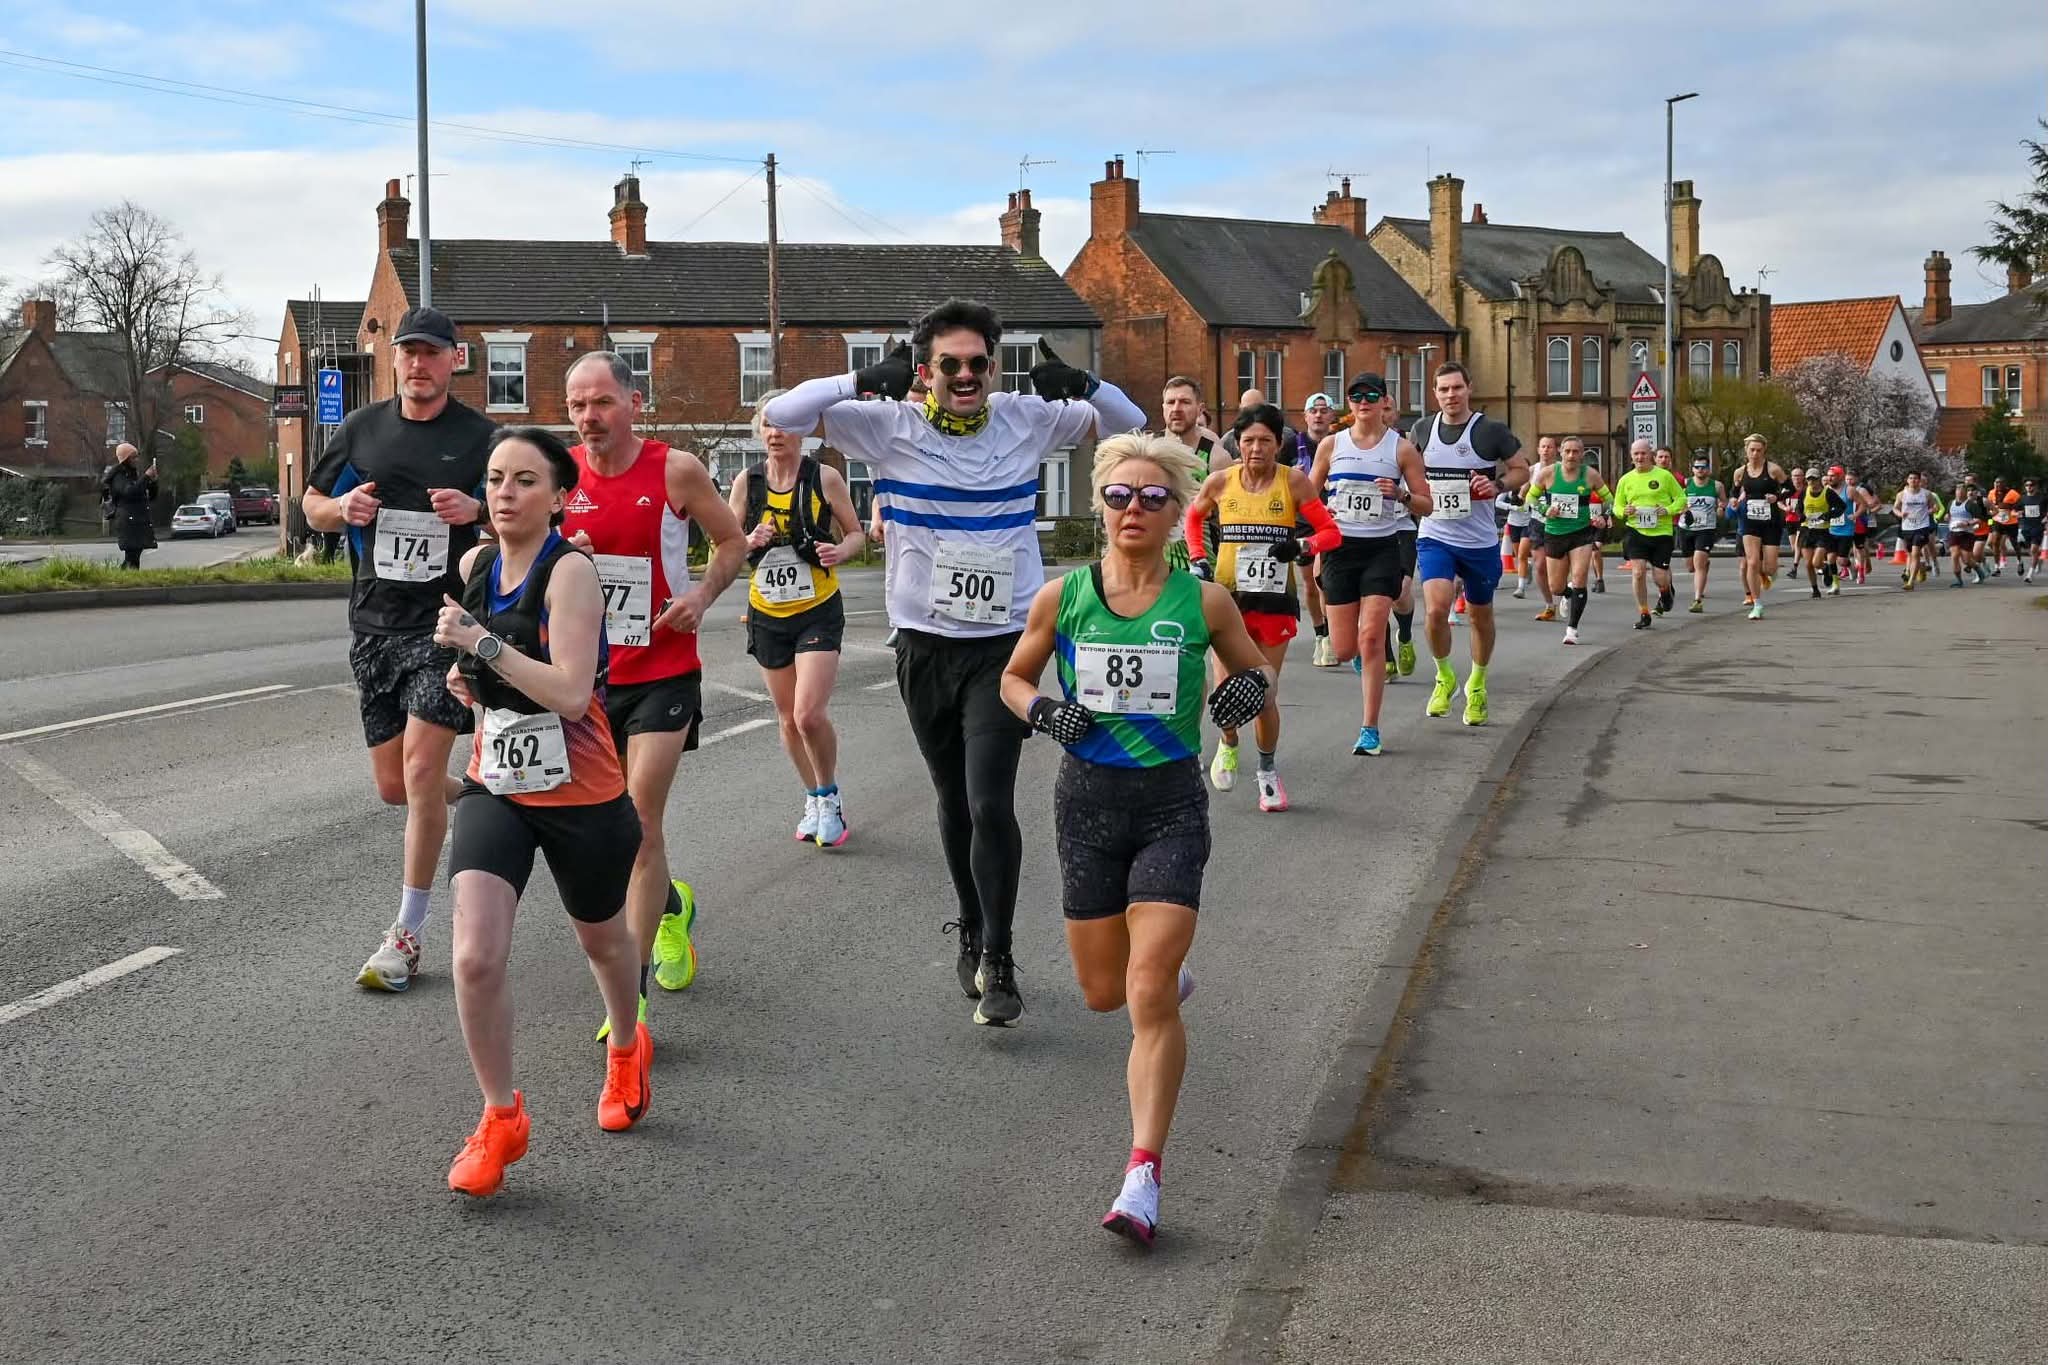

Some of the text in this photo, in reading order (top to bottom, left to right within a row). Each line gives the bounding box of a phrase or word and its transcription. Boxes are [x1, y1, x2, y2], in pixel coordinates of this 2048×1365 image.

[1638, 423, 1653, 433] 20
[1348, 495, 1371, 511] 130
[1439, 494, 1460, 509] 153
[394, 536, 429, 562] 174
[766, 566, 798, 588] 469
[1247, 561, 1277, 579] 615
[949, 572, 995, 602] 500
[602, 584, 632, 611] 77
[624, 635, 642, 645] 677
[1106, 654, 1144, 688] 83
[511, 726, 544, 736] MARATHON
[492, 734, 542, 769] 262
